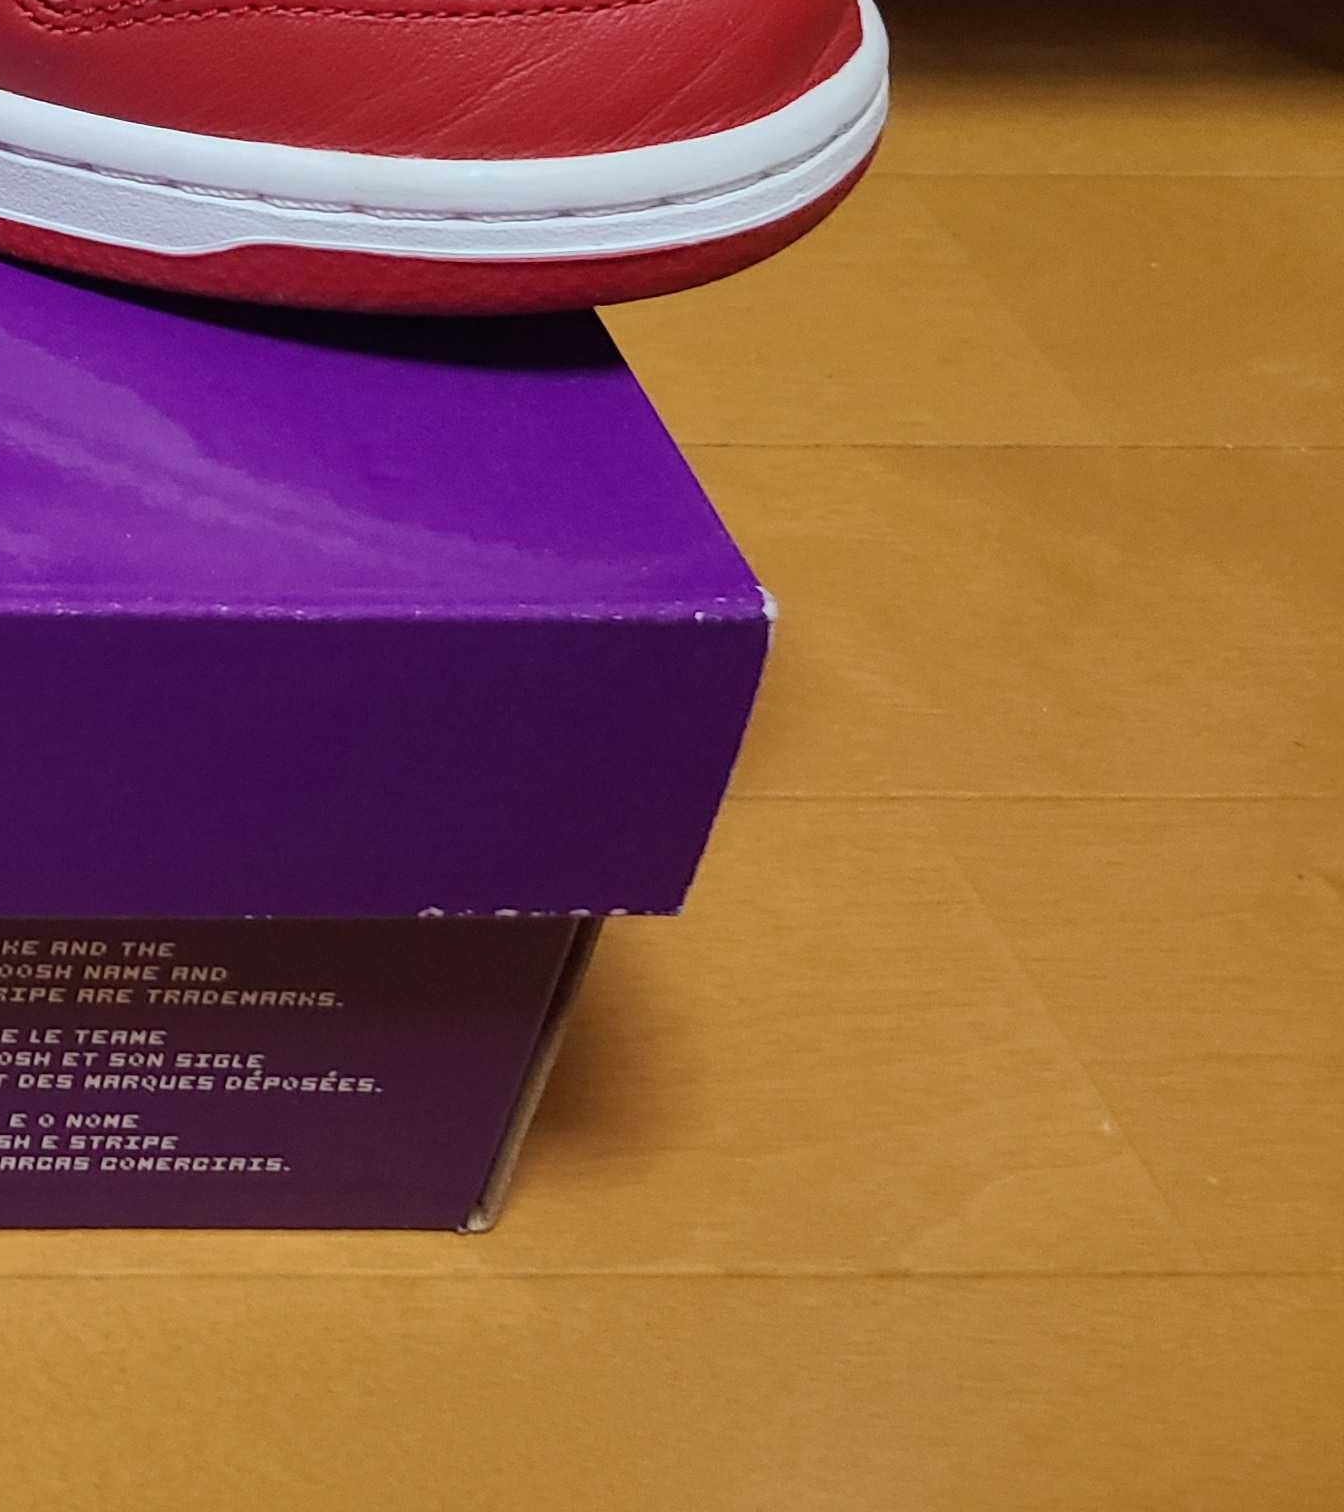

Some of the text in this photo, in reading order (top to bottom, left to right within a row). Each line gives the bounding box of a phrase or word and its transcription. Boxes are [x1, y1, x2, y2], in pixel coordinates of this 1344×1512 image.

[50, 940, 107, 957] AND
[121, 941, 176, 958] THE
[83, 965, 160, 981] NAME
[171, 966, 228, 982] AND
[76, 988, 134, 1004] ARE
[29, 1029, 62, 1044] LE
[62, 1052, 99, 1067] ET
[108, 1052, 164, 1068] SON
[175, 1052, 266, 1071] SIGLE
[18, 1073, 74, 1090] DES
[84, 1074, 215, 1092] MARQUES
[9, 1113, 27, 1128] E
[38, 1113, 55, 1128] O
[65, 1113, 139, 1129] NOME
[41, 1135, 59, 1150] E
[69, 1135, 179, 1150] STRIPE
